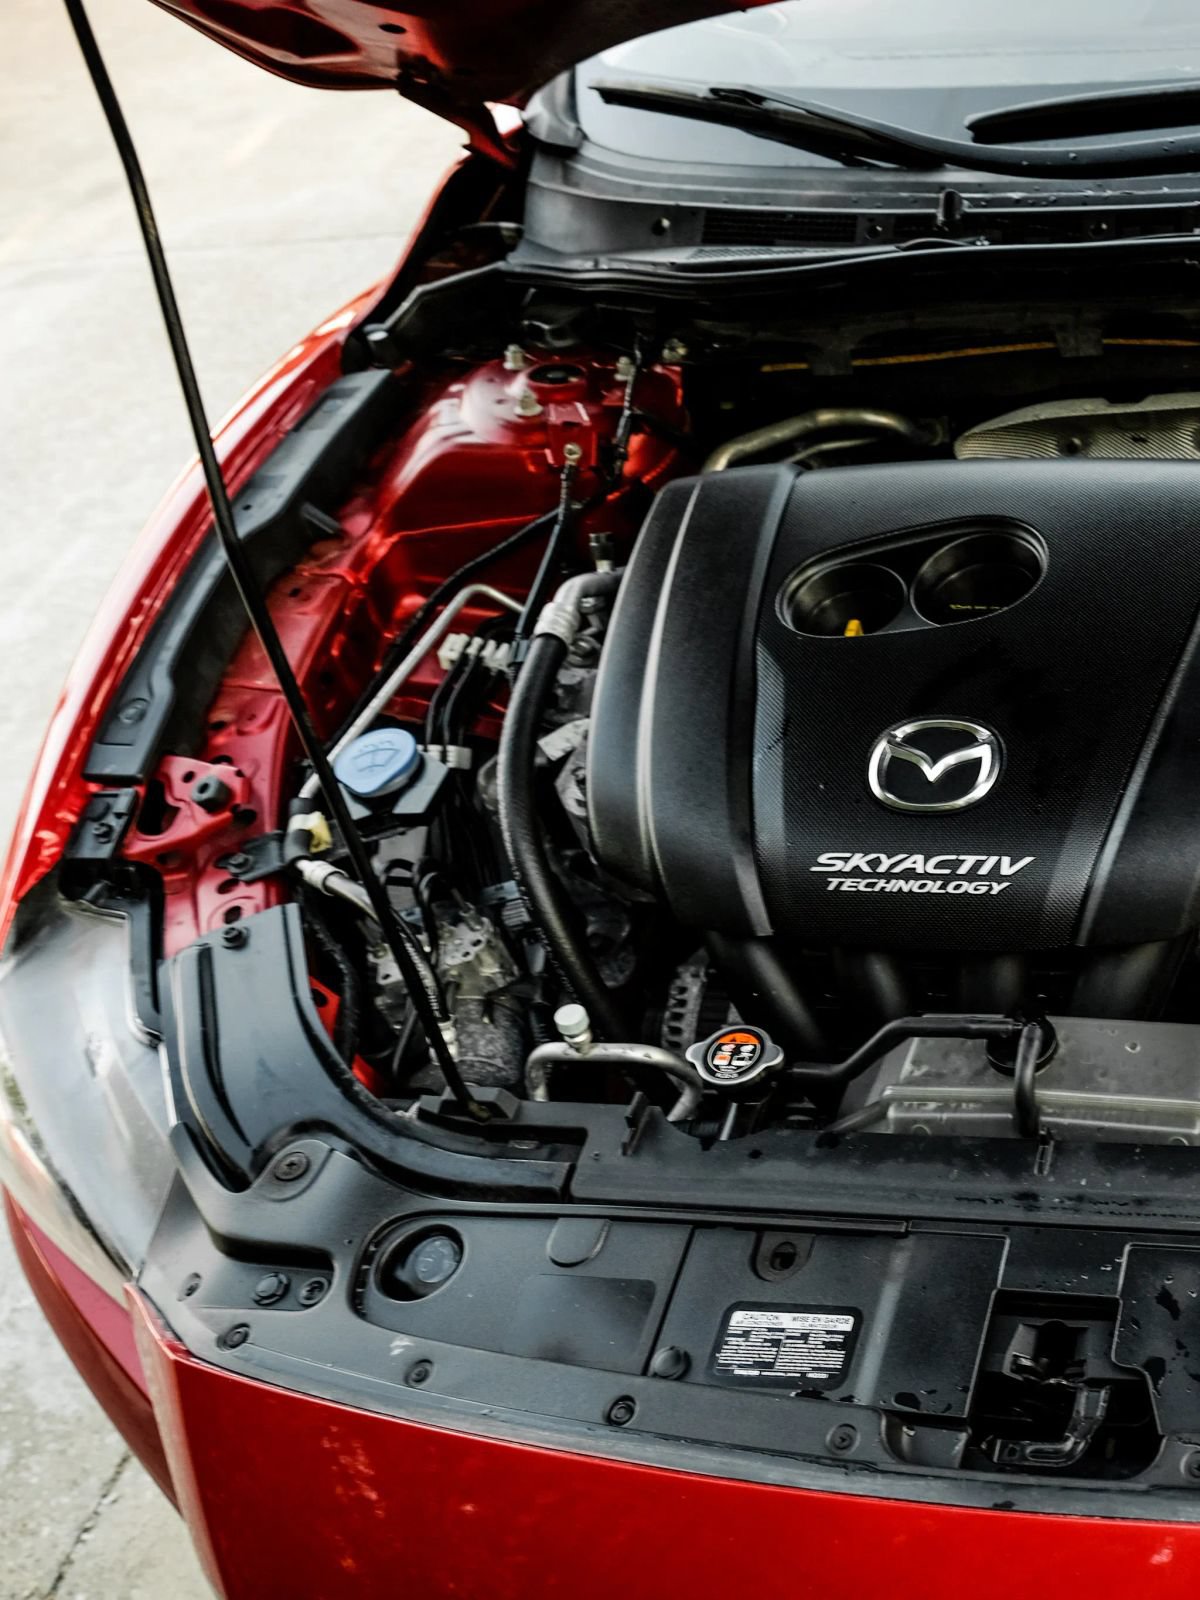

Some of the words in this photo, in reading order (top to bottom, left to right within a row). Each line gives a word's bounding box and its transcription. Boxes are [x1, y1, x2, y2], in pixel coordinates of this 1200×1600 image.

[809, 852, 1036, 876] SKYACTIV
[826, 877, 1012, 895] TECHNOLOGY
[743, 1313, 779, 1321] CAUTION
[824, 1316, 851, 1325] GARDE
